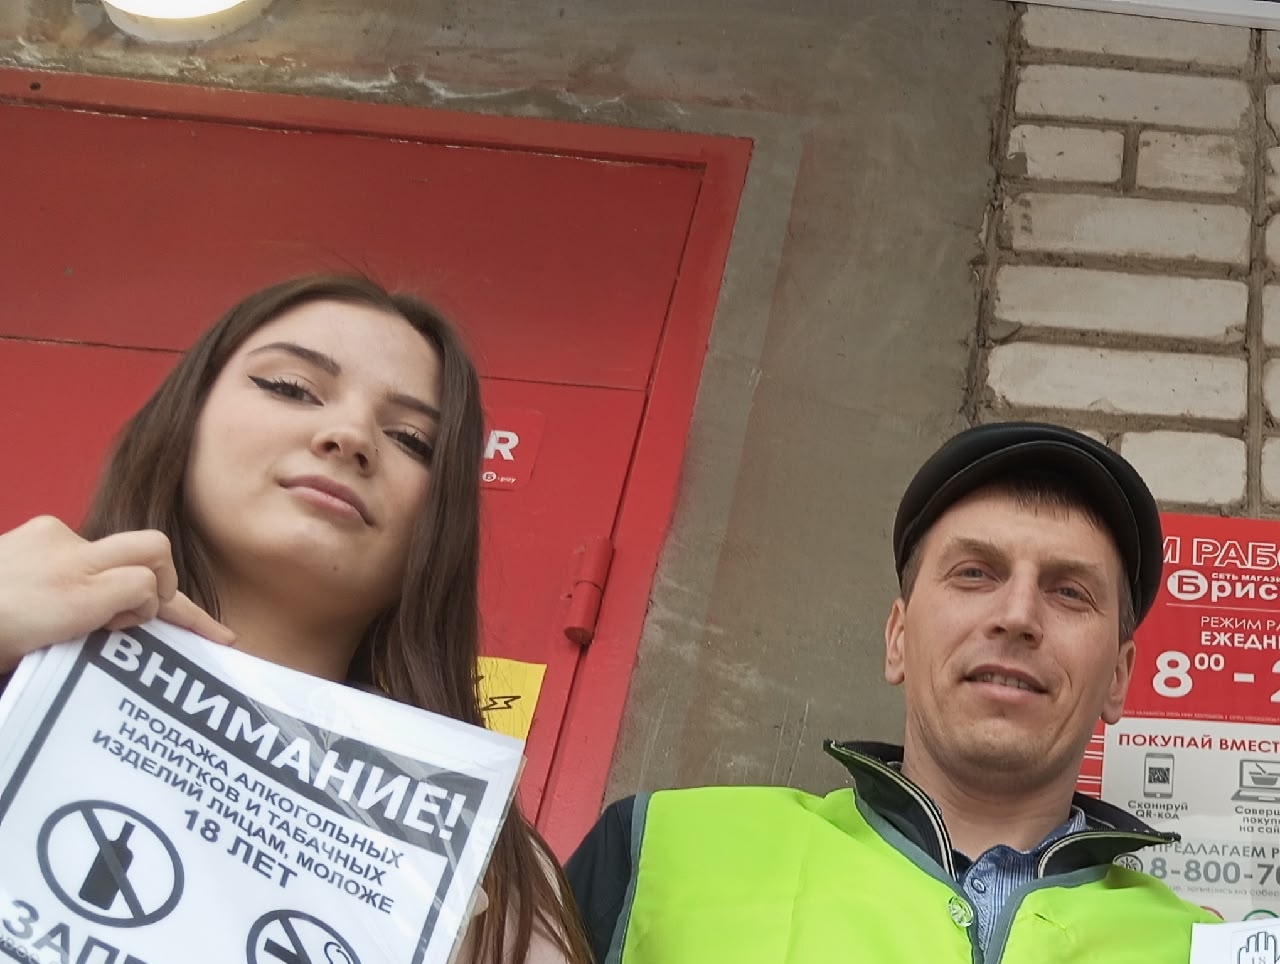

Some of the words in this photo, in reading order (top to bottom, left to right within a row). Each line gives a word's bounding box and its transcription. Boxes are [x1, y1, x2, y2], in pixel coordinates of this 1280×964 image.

[1201, 616, 1262, 631] РЕЖИМ
[1211, 572, 1239, 581] СЕТЬ
[100, 629, 468, 842] ВНИМАНИЕ!
[119, 697, 229, 777] ПРОДАЖА
[235, 771, 405, 869] АЛКОГОЛЬНЫХ
[1119, 732, 1213, 750] ПОКУПАЙ
[92, 729, 205, 802] ИЗДЕЛИЙ
[206, 795, 289, 860] ЛИЦАМ,
[295, 850, 395, 915] МОЛОЖЕ
[118, 721, 242, 803] НАПИТКОВ
[245, 798, 262, 816] И
[268, 808, 389, 887] ТАБАЧНЫХ
[183, 808, 222, 843] 18
[227, 835, 298, 889] ЛЕТ
